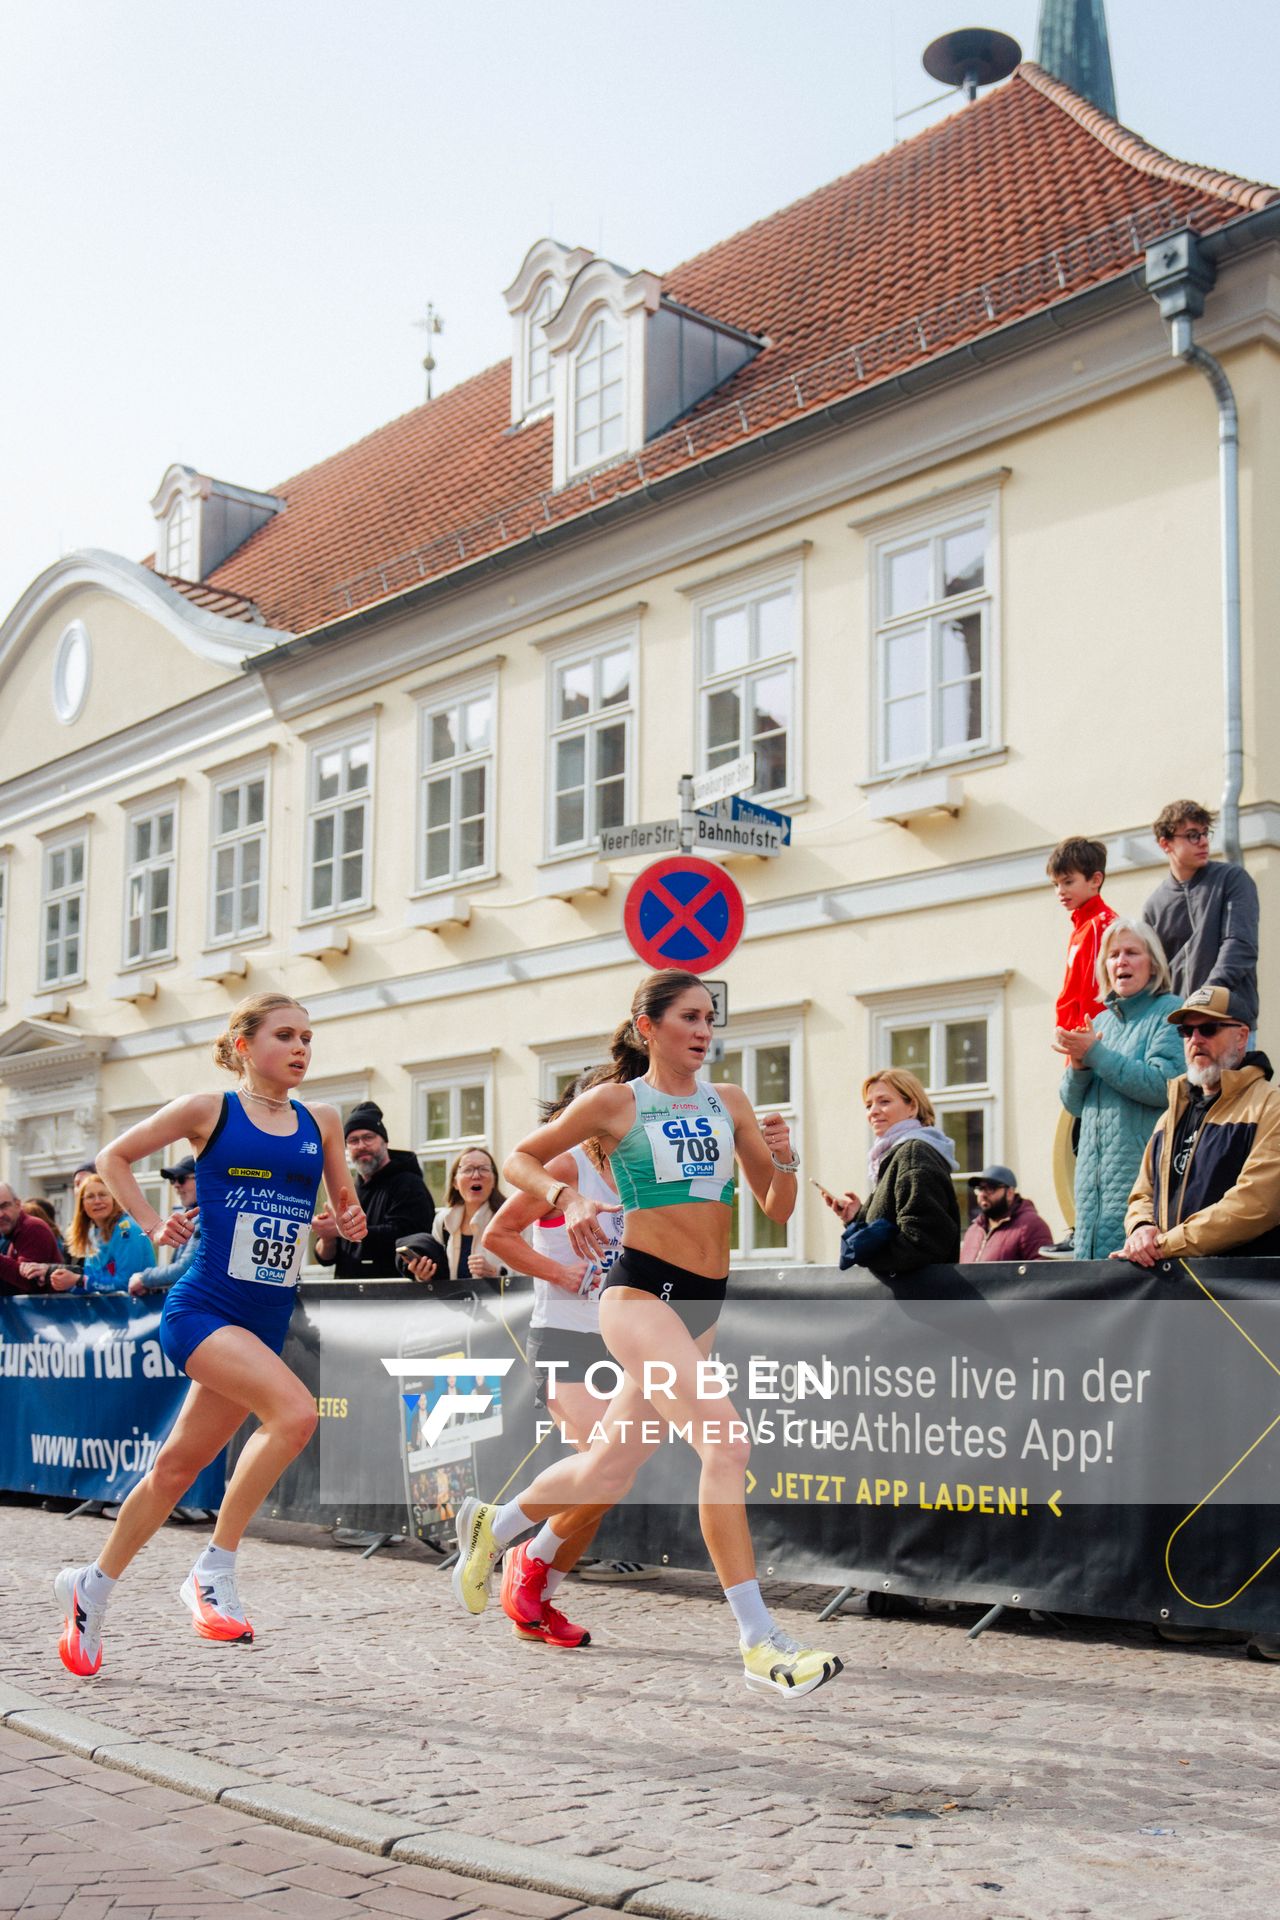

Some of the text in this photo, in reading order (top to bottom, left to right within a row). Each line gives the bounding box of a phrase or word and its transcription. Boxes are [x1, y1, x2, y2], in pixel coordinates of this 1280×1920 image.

[602, 826, 675, 851] Veerßer Str.
[699, 820, 778, 849] Bahnhofstr.
[669, 1136, 720, 1163] 708
[240, 1169, 261, 1177] HORN
[696, 1164, 714, 1172] PLAN
[251, 1187, 276, 1199] LAV
[252, 1200, 311, 1220] TÜBINGEN
[251, 1238, 296, 1270] 933
[0, 1333, 86, 1379] urstrom
[951, 1356, 1017, 1401] live
[1031, 1357, 1067, 1402] in
[1082, 1357, 1151, 1404] der
[313, 1397, 348, 1418] ETES
[776, 1408, 1007, 1459] TrueAthletes
[1020, 1417, 1115, 1473] App!
[770, 1471, 1029, 1517] JETZT APP LADEN!
